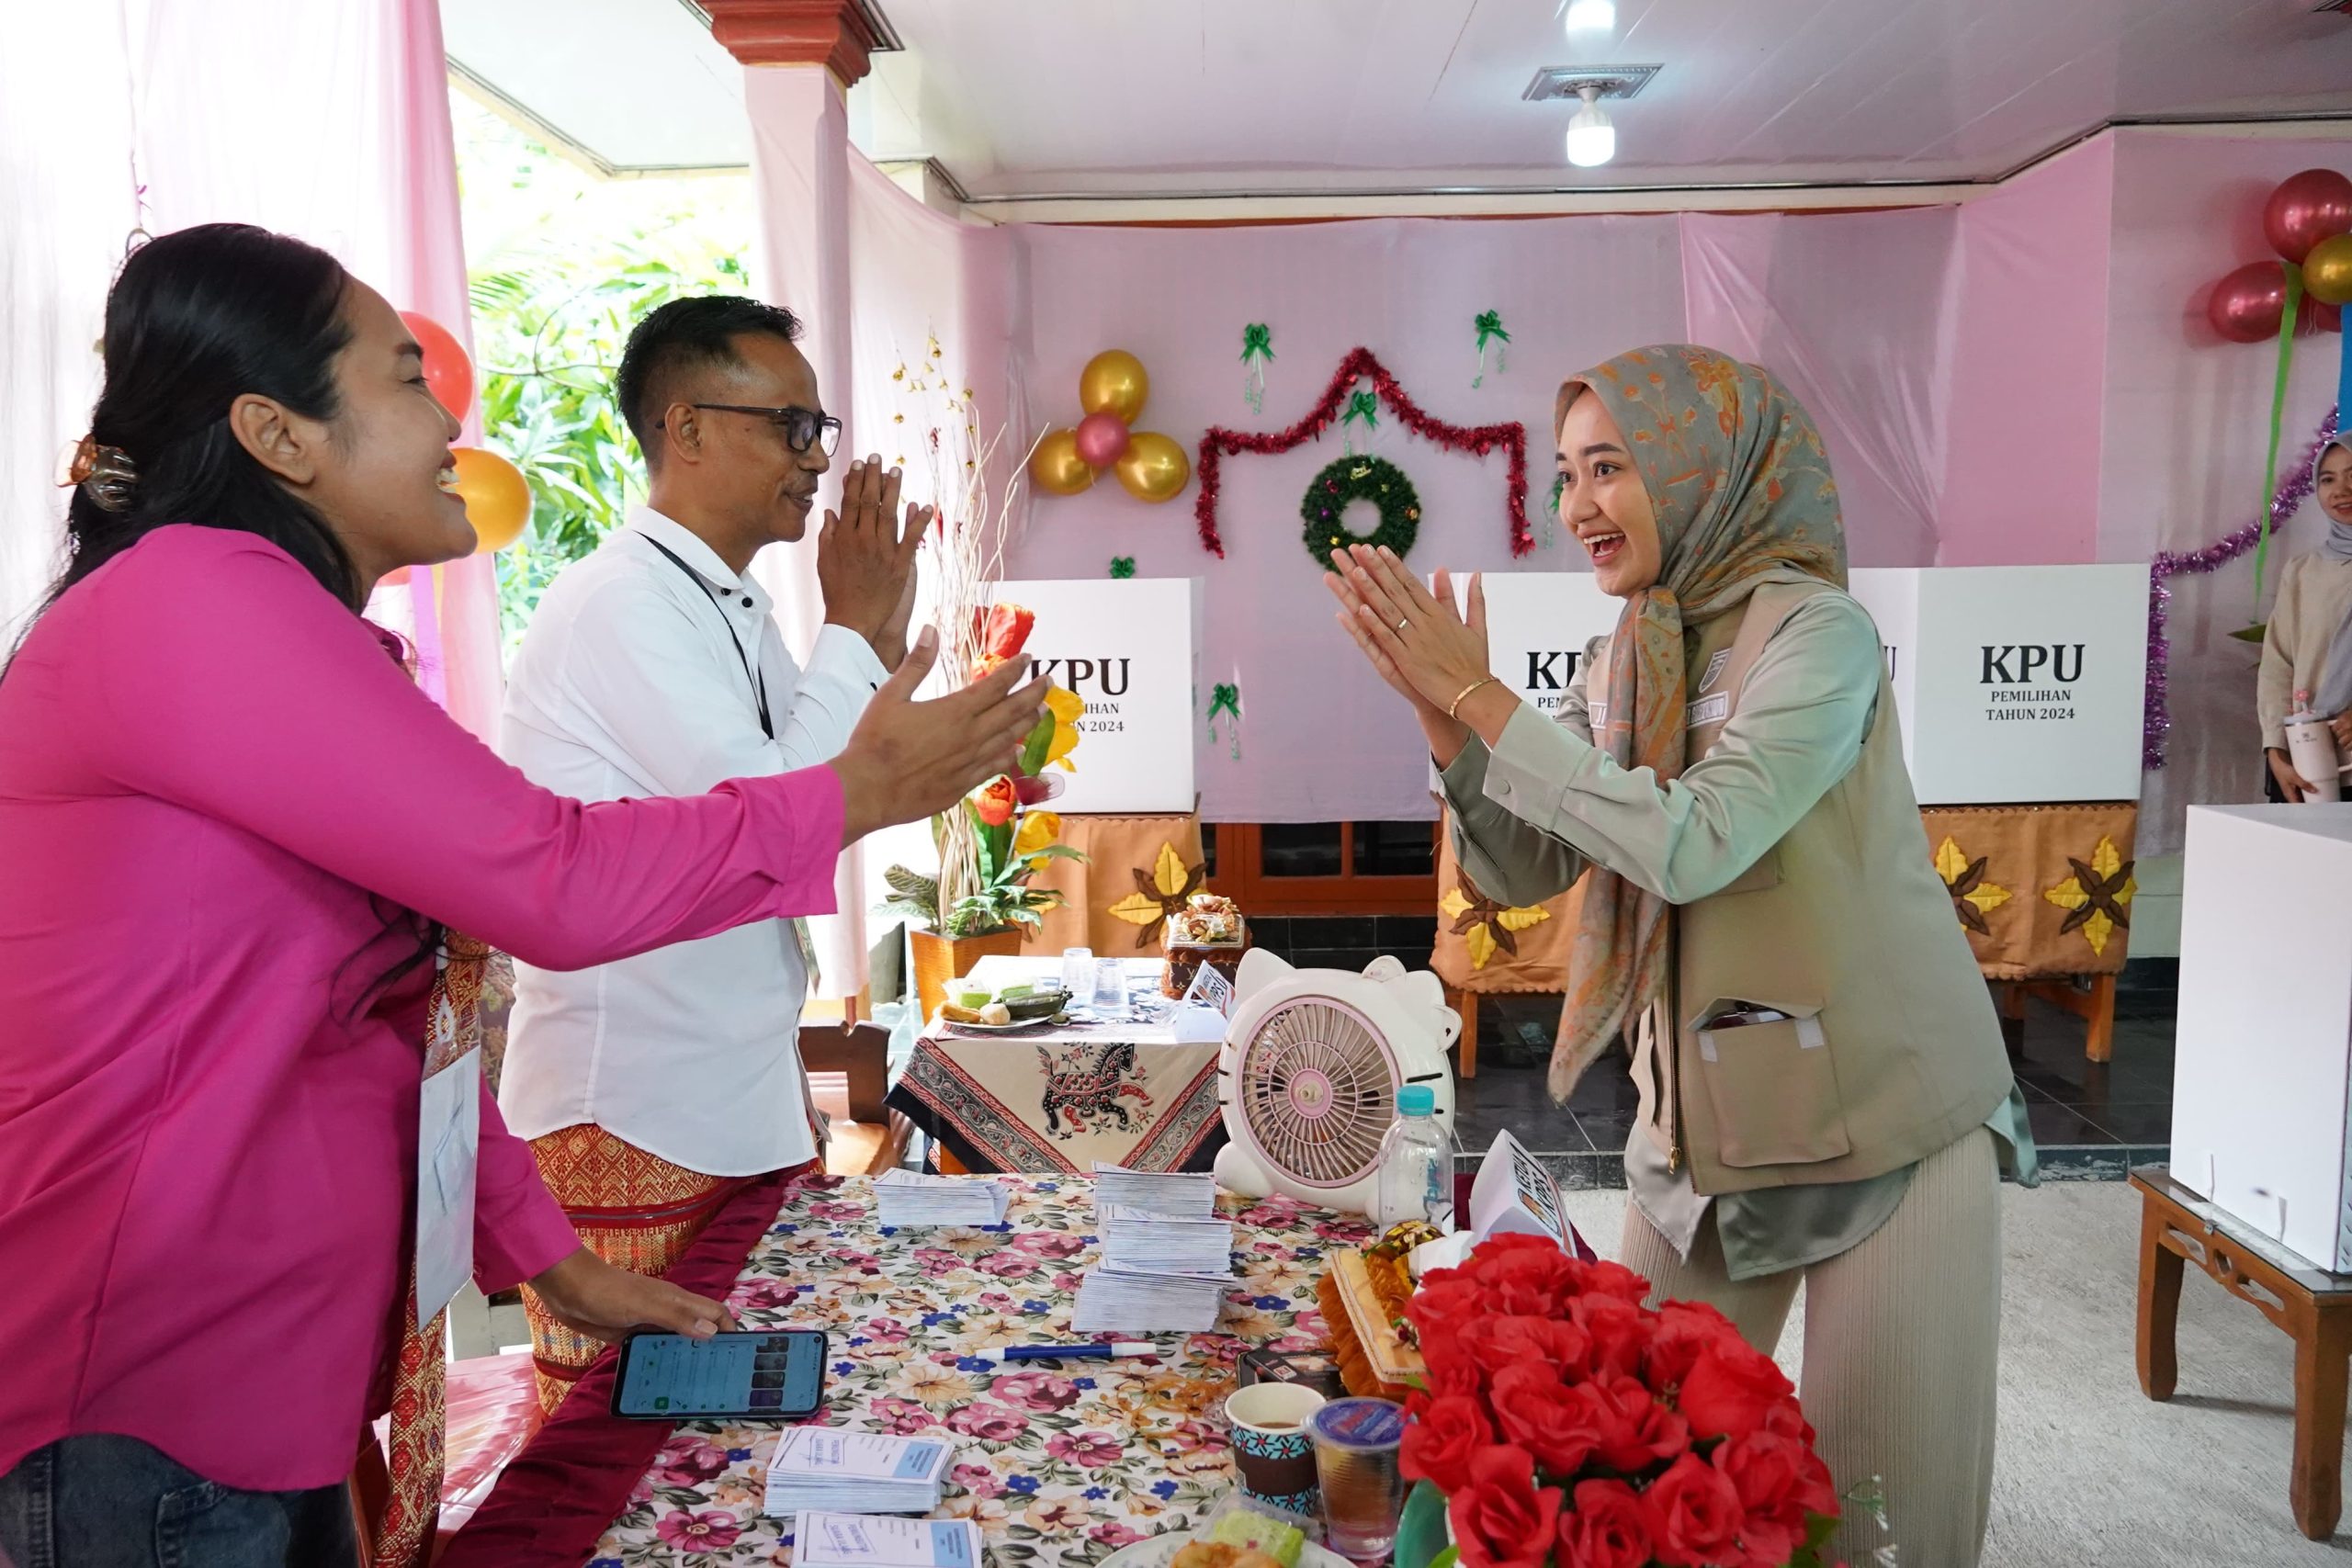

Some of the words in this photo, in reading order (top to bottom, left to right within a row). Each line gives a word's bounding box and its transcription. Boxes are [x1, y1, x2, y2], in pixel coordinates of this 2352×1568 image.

[1980, 644, 2086, 683] KPU
[1991, 690, 2071, 702] PEMILIHAN
[1985, 708, 2036, 720] TAHUN
[2040, 707, 2075, 719] 2024
[1090, 721, 1124, 732] 2024
[1532, 1171, 1556, 1217] KPPS
